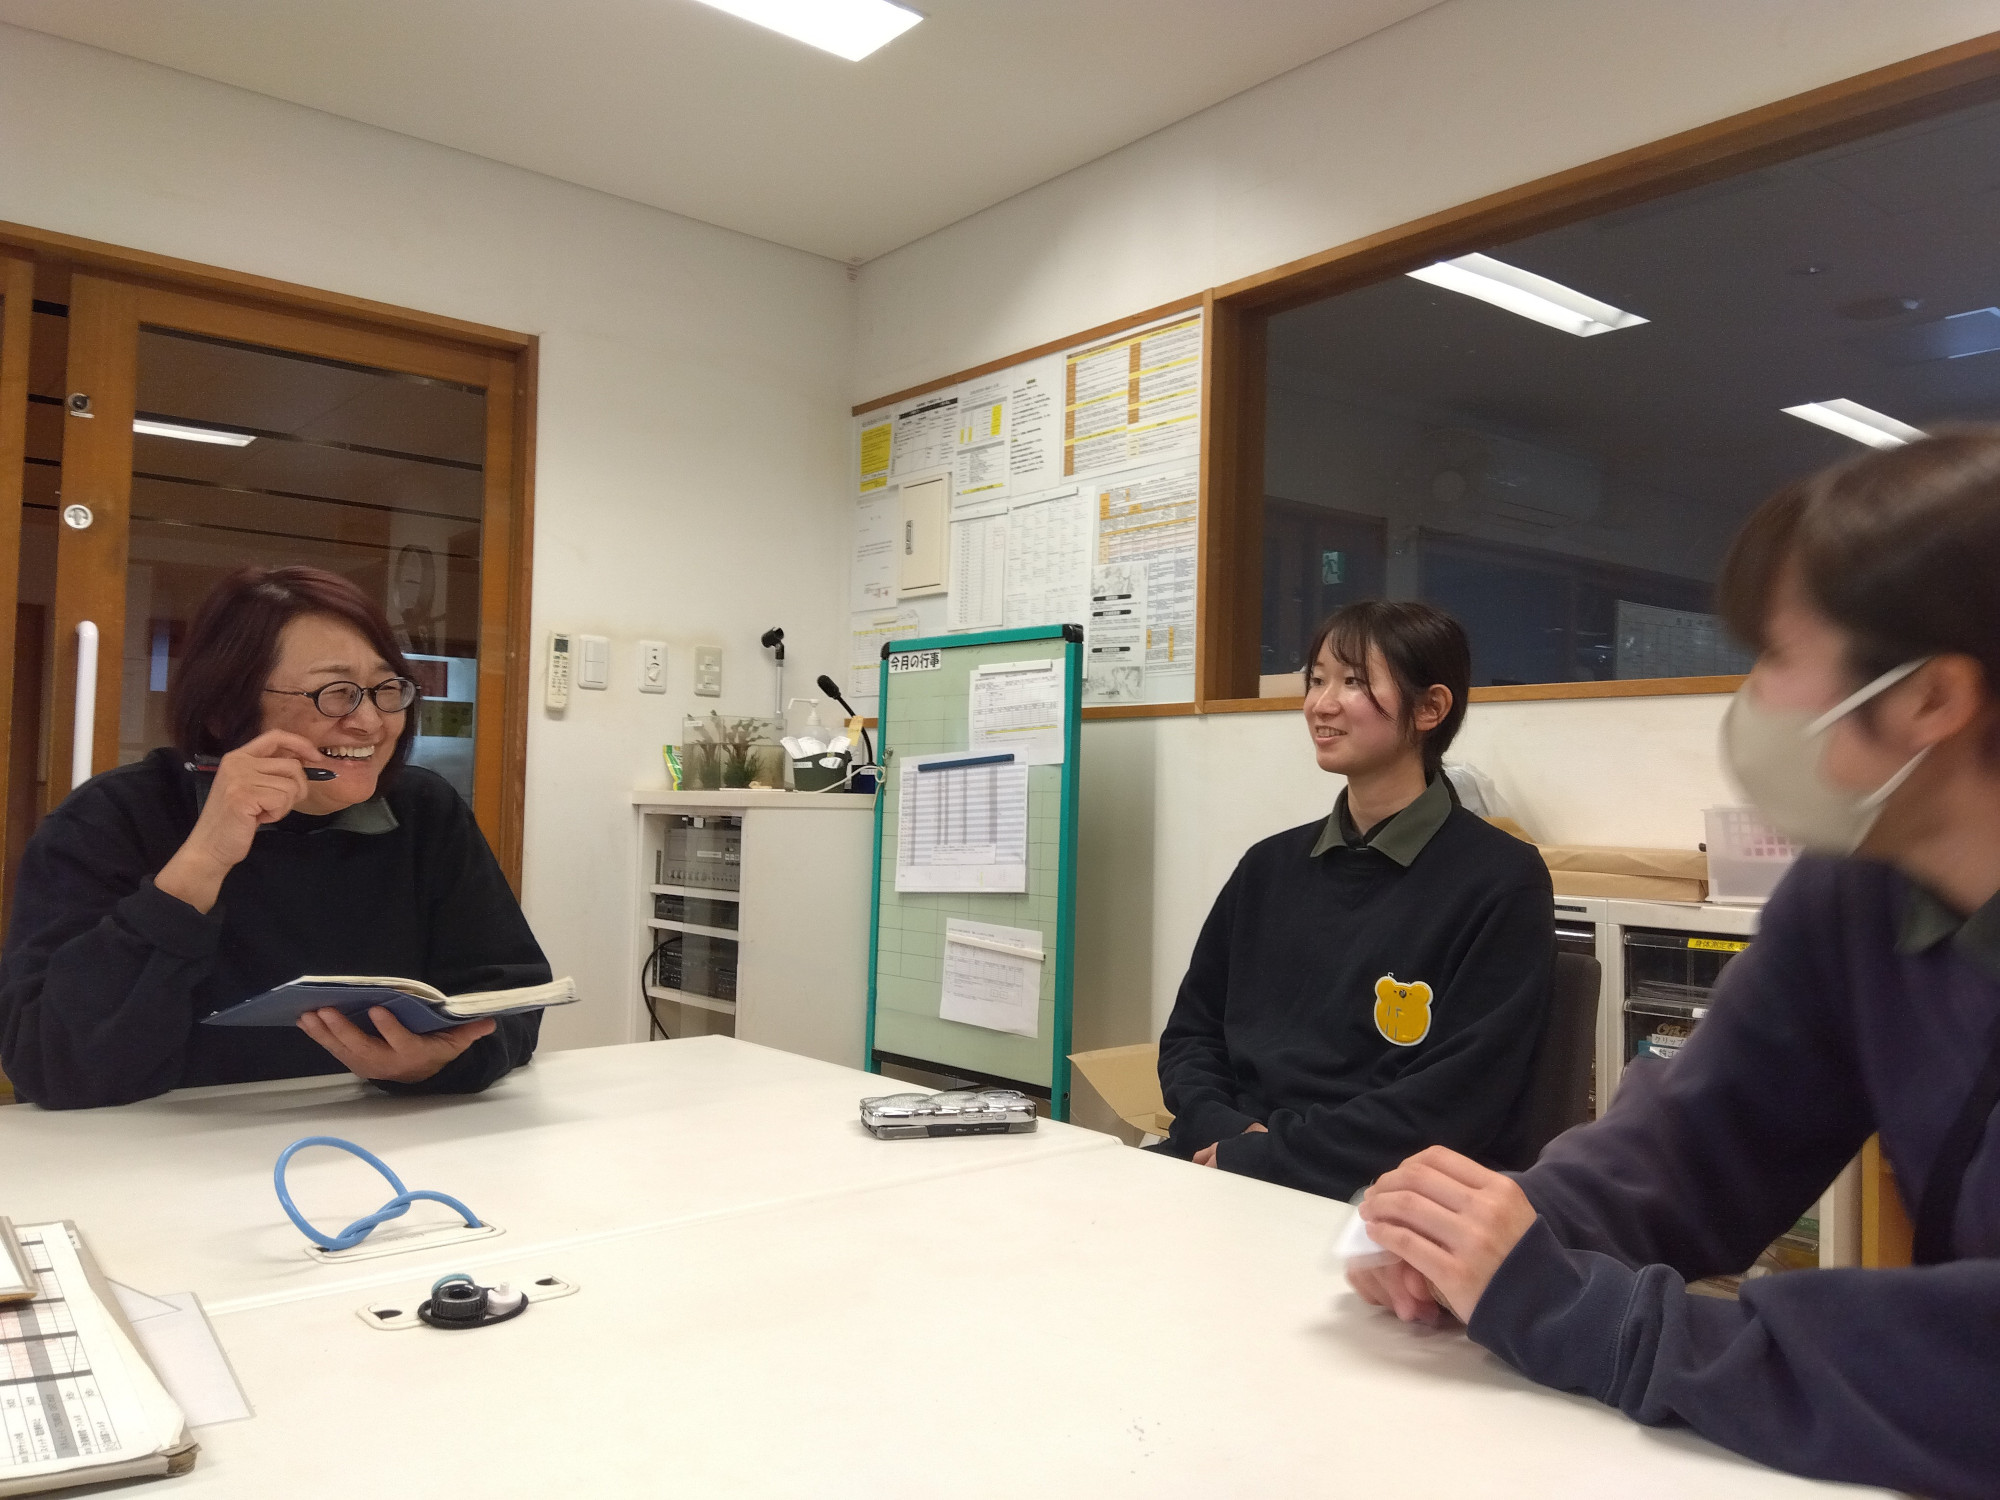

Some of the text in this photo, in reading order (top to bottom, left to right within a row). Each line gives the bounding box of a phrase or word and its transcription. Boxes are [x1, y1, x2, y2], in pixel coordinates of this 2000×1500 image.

[890, 651, 940, 671] 今月の行事
